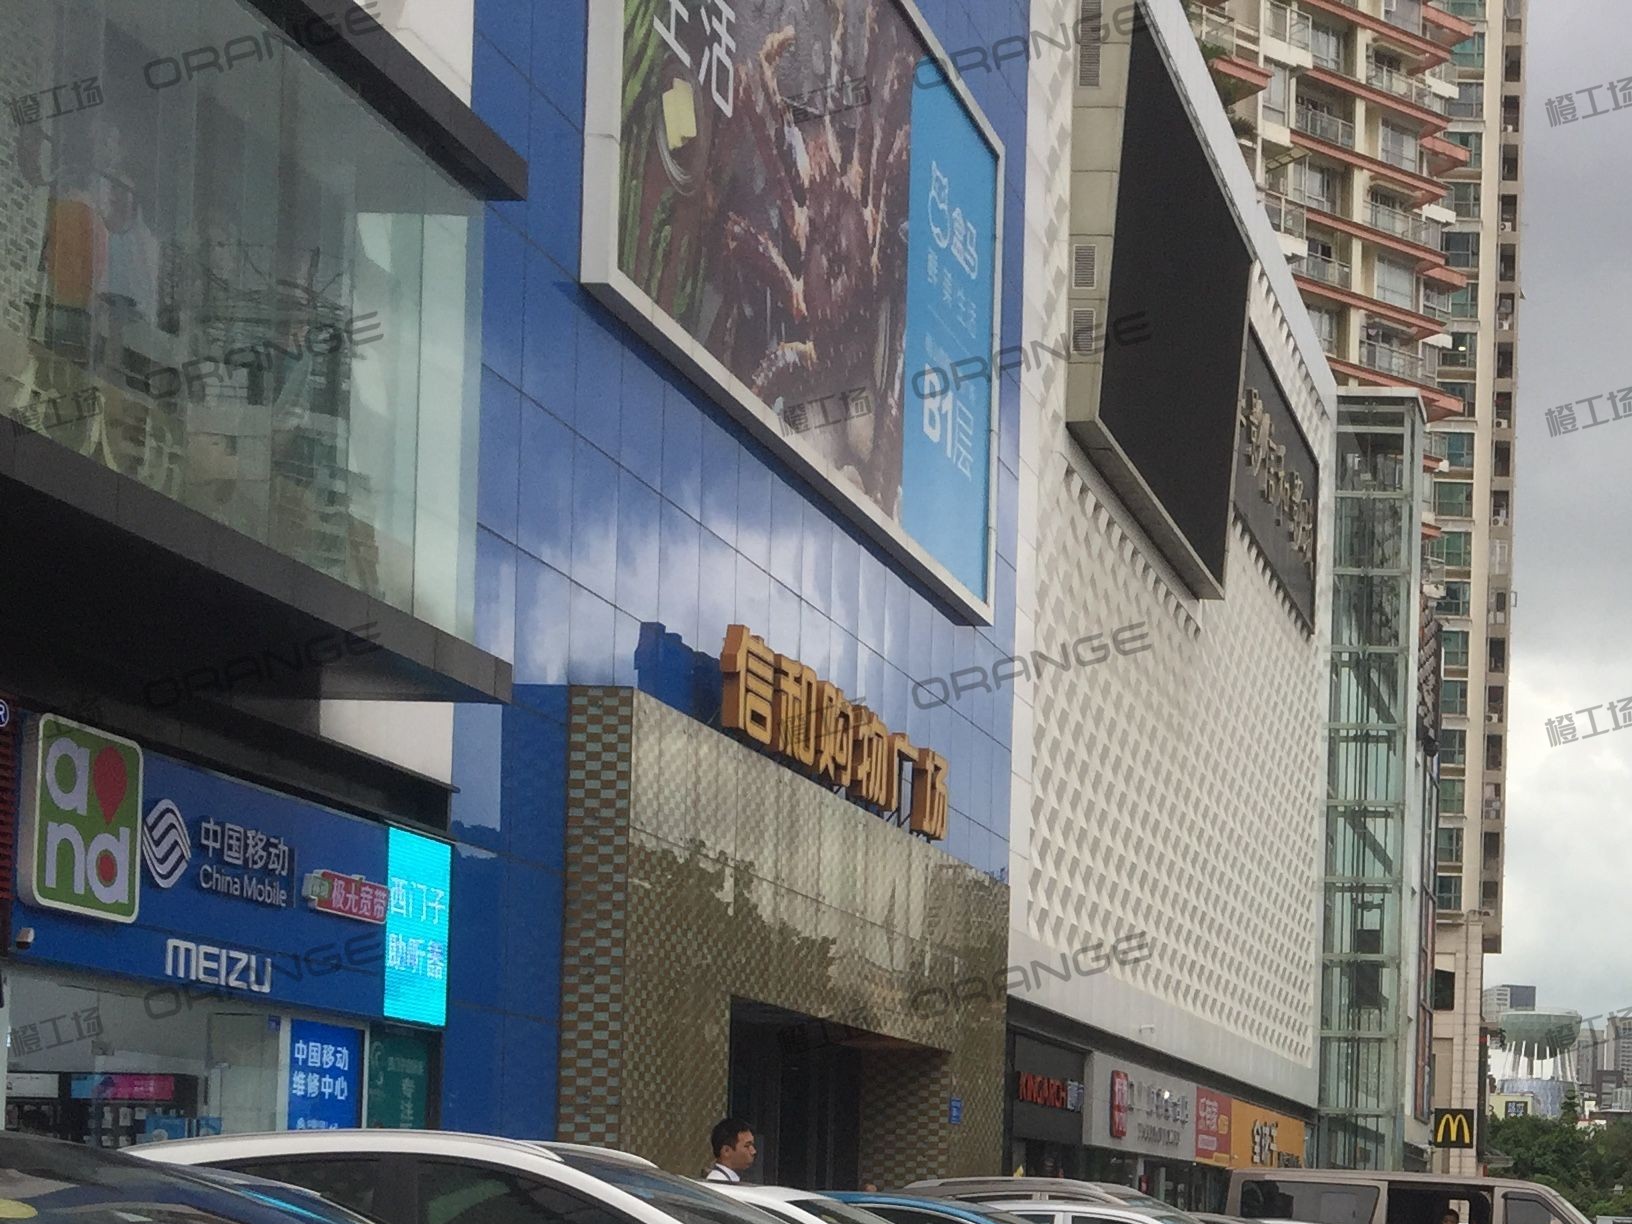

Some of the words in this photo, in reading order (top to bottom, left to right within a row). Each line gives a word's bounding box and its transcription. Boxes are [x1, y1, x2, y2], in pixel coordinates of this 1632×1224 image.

[923, 362, 975, 482] B1层
[722, 623, 949, 842] 信和购物广场
[199, 817, 289, 877] 中国移动
[199, 864, 241, 896] China
[243, 875, 288, 908] Mobile
[389, 876, 446, 925] 西门子
[164, 938, 272, 993] MEIZU
[386, 933, 444, 980] 助听器
[294, 1039, 349, 1071] 中国移动
[291, 1070, 349, 1101] 维修中心
